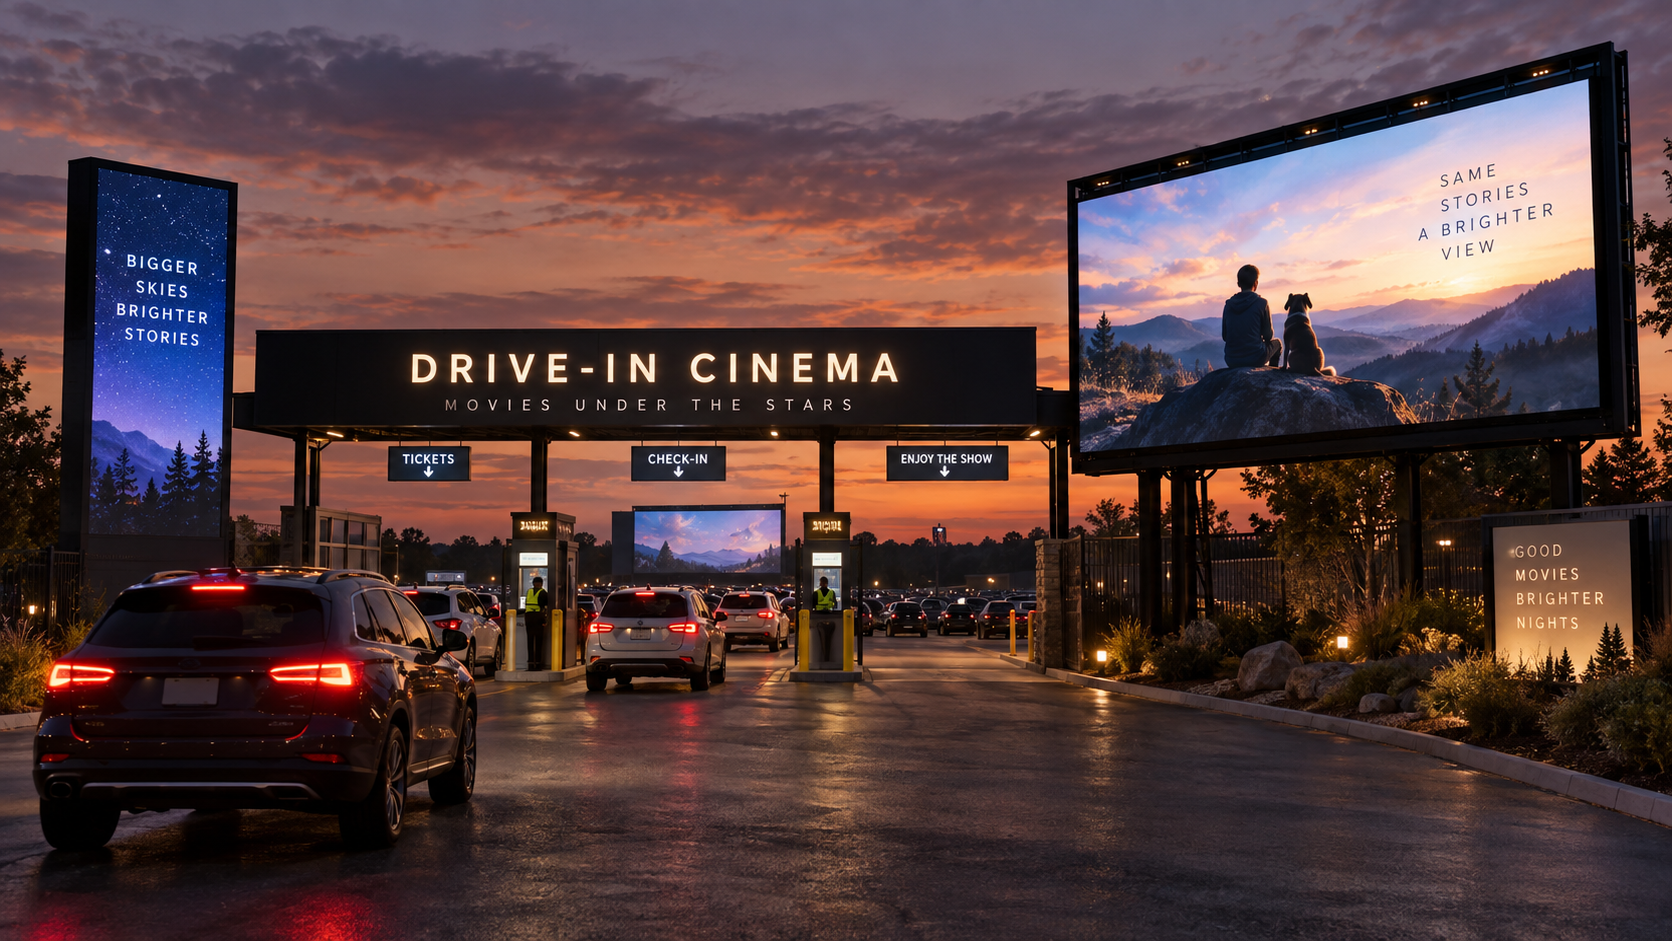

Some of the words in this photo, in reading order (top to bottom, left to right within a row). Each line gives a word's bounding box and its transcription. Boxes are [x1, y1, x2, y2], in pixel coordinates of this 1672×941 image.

[1440, 163, 1496, 188] SAME
[1441, 181, 1529, 213] STORIES
[1418, 227, 1429, 242] A
[1442, 203, 1553, 236] BRIGHTER
[1441, 239, 1495, 261] VIEW
[127, 254, 197, 275] BIGGER
[136, 280, 188, 299] SKIES
[116, 302, 208, 325] BRIGHTER
[125, 327, 199, 346] STORIES
[411, 353, 656, 383] DRIVE-IN
[690, 353, 899, 384] CINEMA
[444, 398, 551, 412] MOVIES
[575, 398, 667, 412] UNDER
[691, 398, 741, 412] THE
[766, 398, 852, 412] STARS
[402, 453, 455, 465] TICKETS
[647, 453, 709, 465] CHECK-IN
[900, 453, 935, 465] ENJOY
[937, 453, 957, 465] THE
[960, 453, 993, 465] SHOW
[1515, 543, 1562, 558] GOOD
[1515, 567, 1579, 581] MOVIES
[1516, 591, 1604, 605] BRIGHTER
[1517, 616, 1579, 630] NIGHTS
